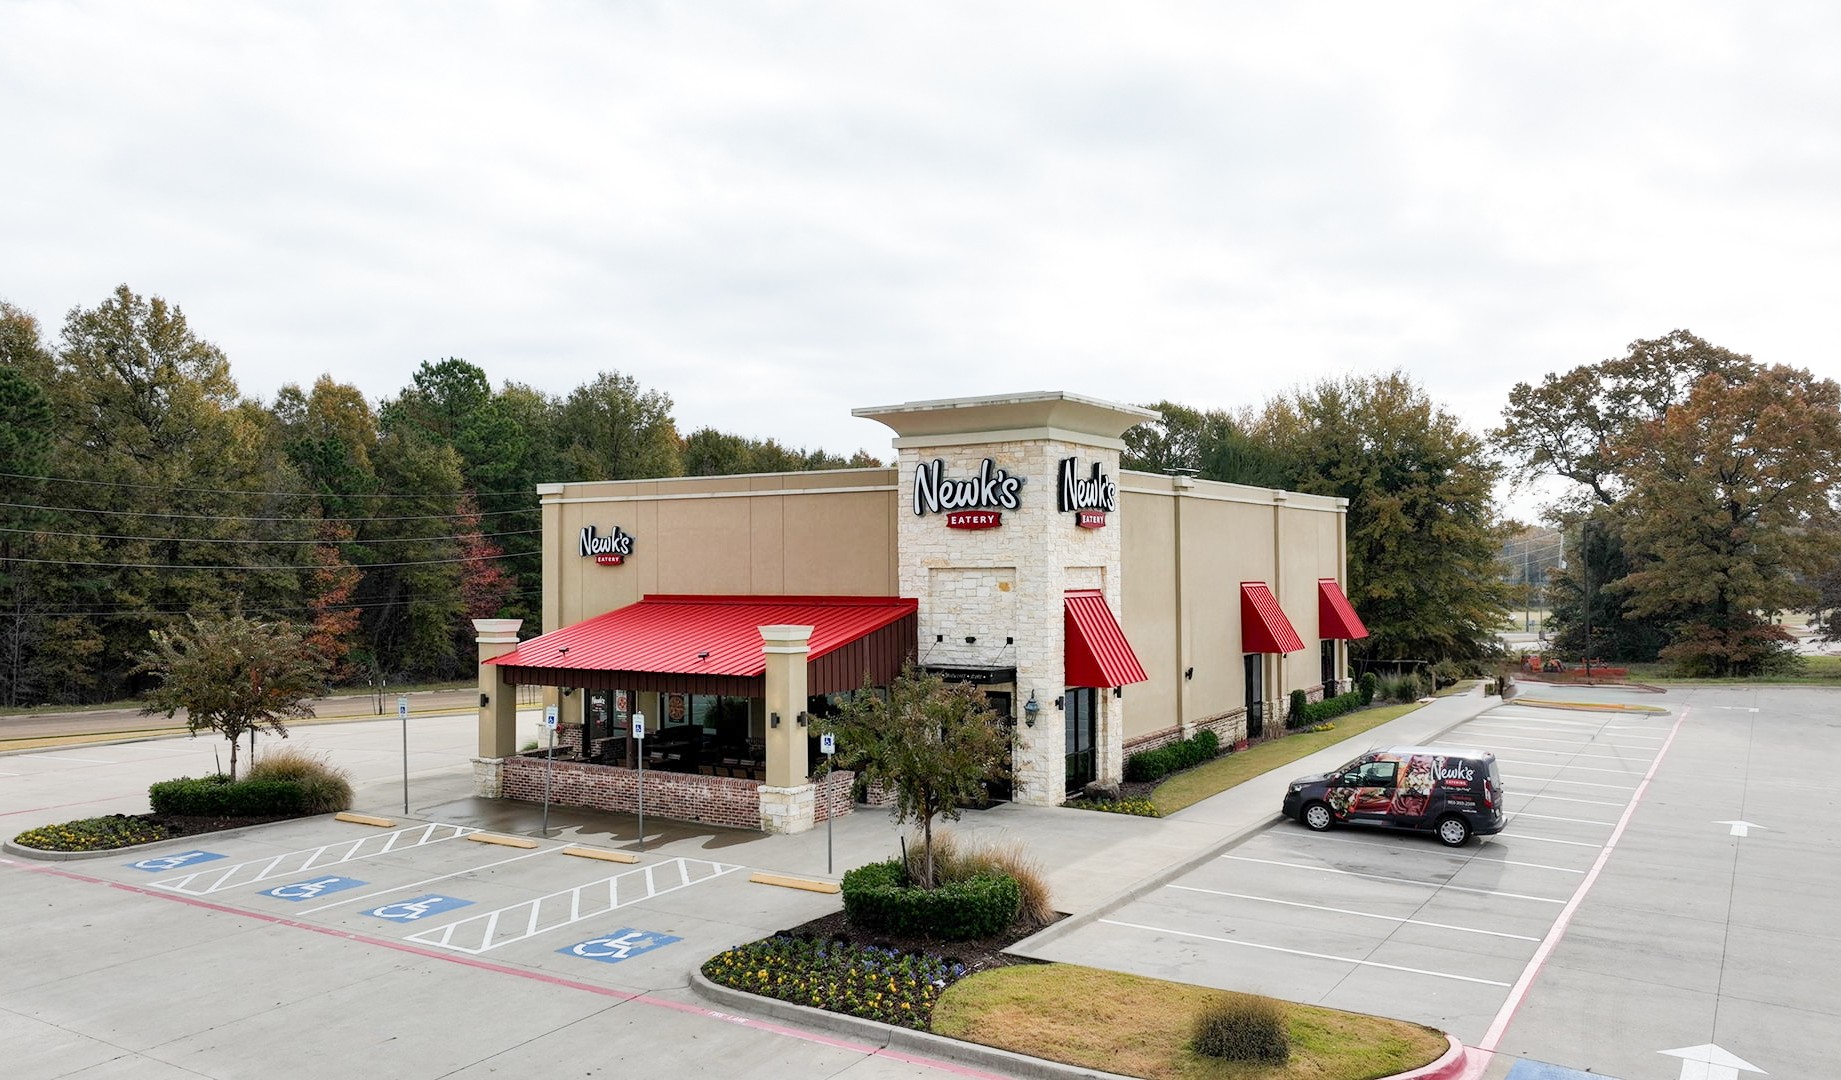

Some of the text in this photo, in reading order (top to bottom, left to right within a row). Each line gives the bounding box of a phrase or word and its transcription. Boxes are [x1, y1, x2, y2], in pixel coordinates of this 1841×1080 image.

[913, 459, 1019, 515] Newk's
[1063, 457, 1115, 512] Newk's
[951, 515, 995, 525] EATERY
[1082, 515, 1104, 524] EATERY
[579, 525, 630, 557] Newk's
[1430, 760, 1474, 781] Newk's
